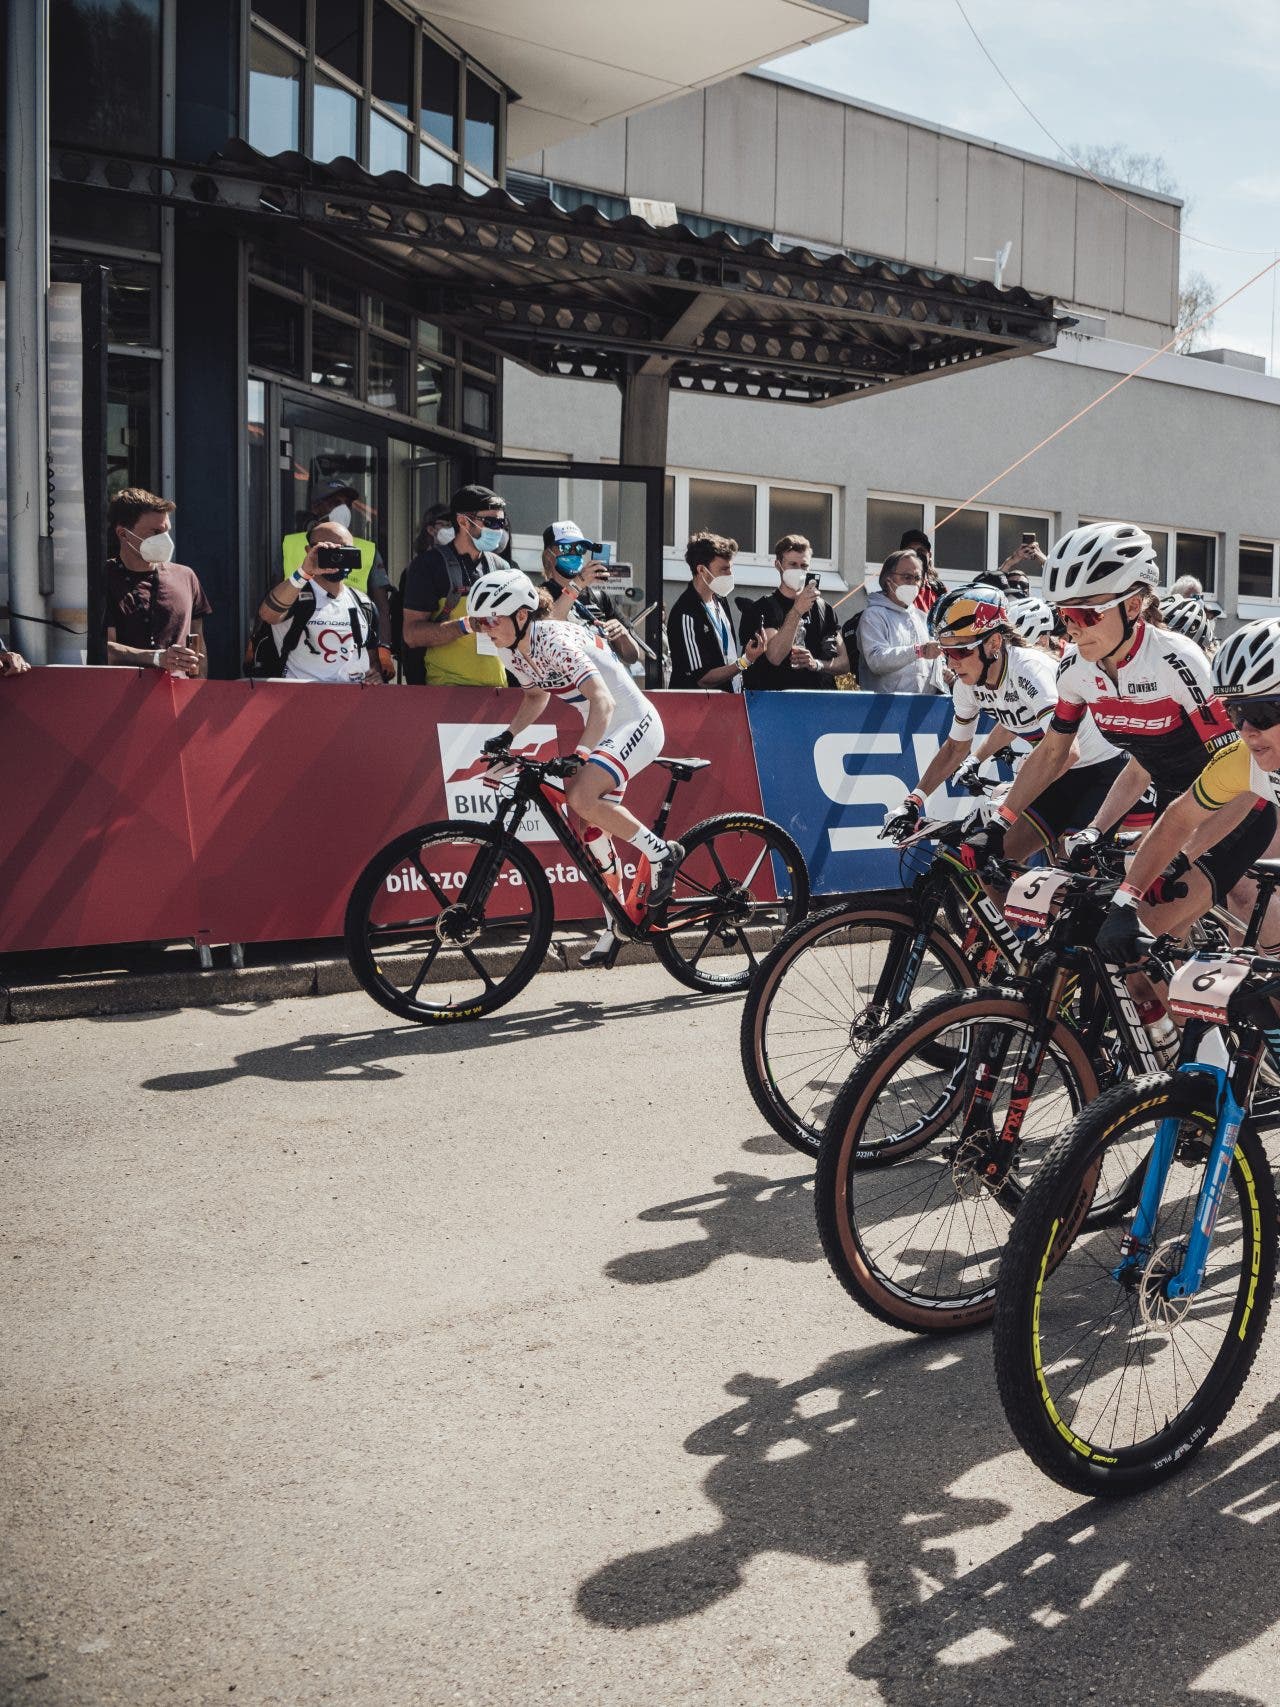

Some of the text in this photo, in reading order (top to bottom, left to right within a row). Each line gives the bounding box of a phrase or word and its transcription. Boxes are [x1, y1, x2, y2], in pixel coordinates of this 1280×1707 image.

[1213, 684, 1244, 694] GENUINS
[619, 711, 653, 760] GHOST
[724, 822, 765, 832] MAXXIS
[644, 833, 668, 854] NW
[386, 863, 637, 893] bikezo-astae
[1023, 876, 1049, 900] 5
[1192, 968, 1222, 992] 6
[1100, 1095, 1170, 1141] MAXXIS
[1152, 1425, 1206, 1470] TEST PILOT
